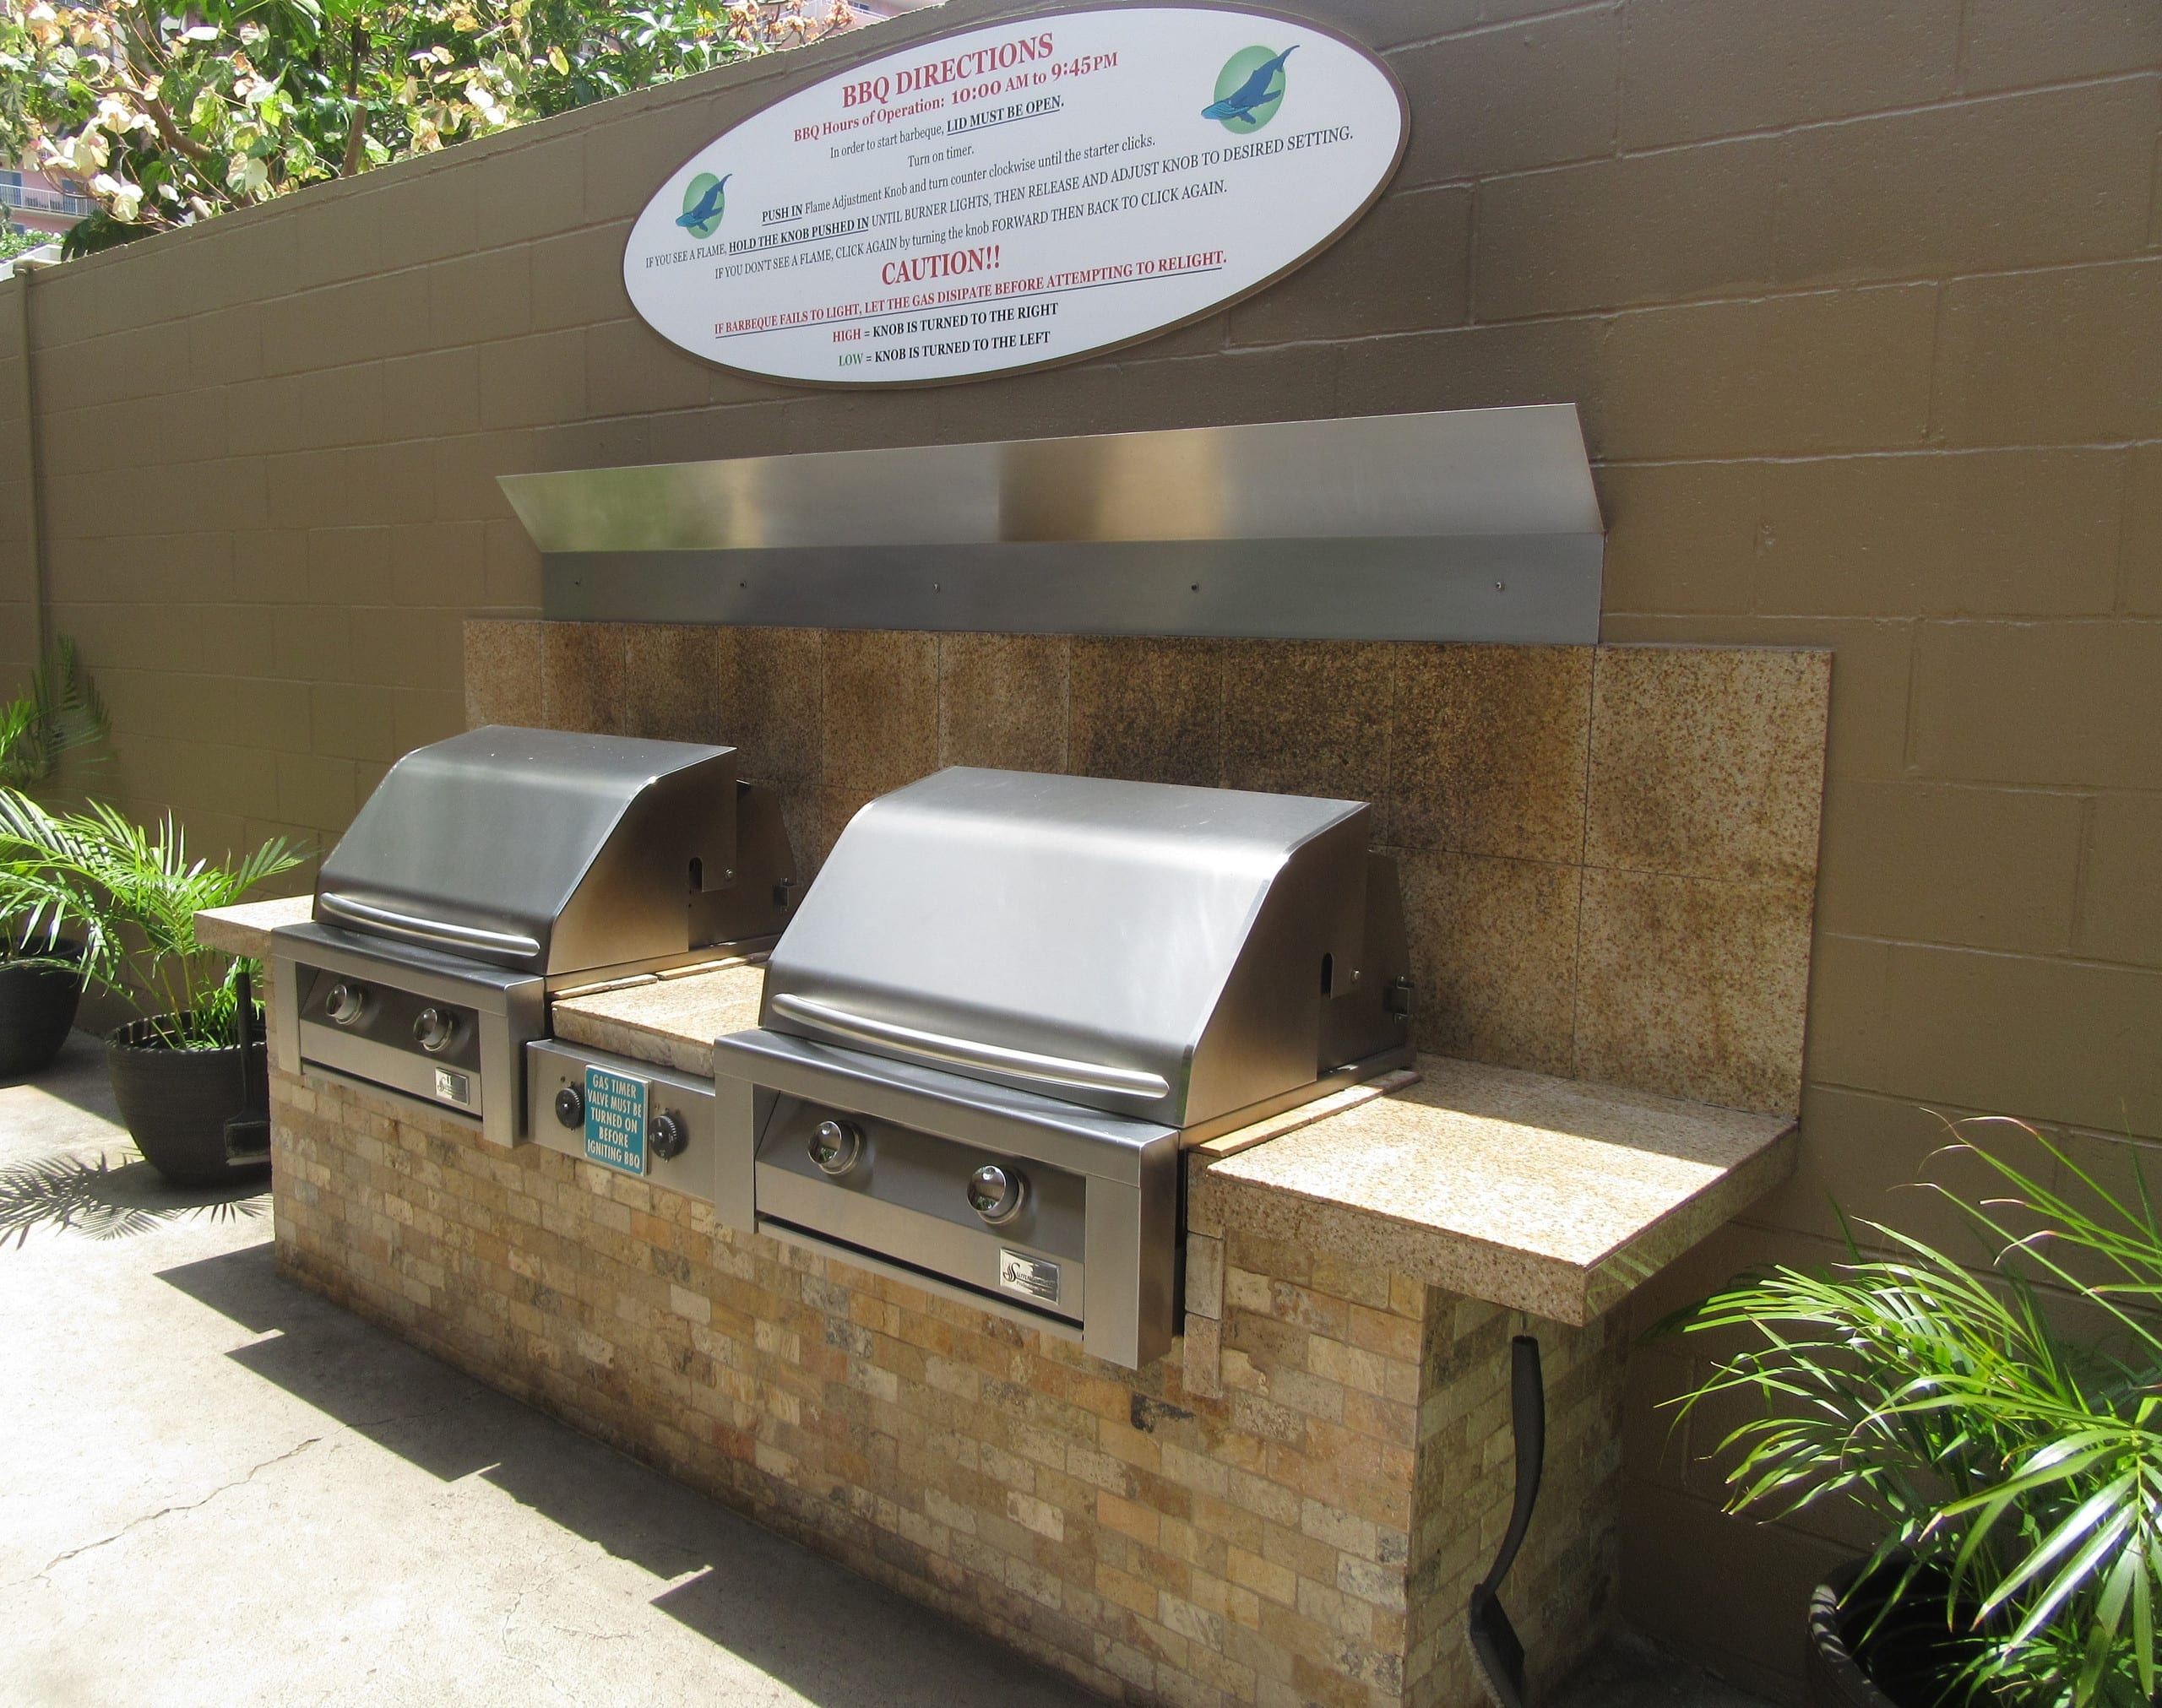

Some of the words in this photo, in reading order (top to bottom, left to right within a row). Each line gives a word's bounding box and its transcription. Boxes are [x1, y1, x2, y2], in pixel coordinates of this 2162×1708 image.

[843, 77, 889, 108] BBQ
[896, 33, 1052, 95] DIRECTIONS
[795, 125, 819, 142] BBQ
[823, 118, 859, 135] Hours
[862, 111, 875, 125] of
[877, 98, 943, 123] Operation:
[952, 81, 1001, 104] 10:00
[1006, 73, 1028, 92] AM
[1033, 73, 1046, 84] to
[831, 147, 839, 158] In
[842, 142, 865, 155] order
[867, 140, 875, 150] to
[877, 134, 897, 148] start
[900, 126, 943, 143] barbeque,
[948, 117, 967, 132] LID
[970, 108, 1004, 127] MUST
[1008, 104, 1023, 118] BE
[1026, 95, 1064, 114] OPEN.
[908, 155, 930, 167] Turn
[932, 152, 943, 162] on
[947, 146, 974, 160] timer.
[646, 257, 653, 268] IF
[655, 253, 671, 266] YOU
[673, 251, 687, 263] SEE
[689, 250, 695, 260] A
[698, 244, 726, 258] FLAME,
[730, 238, 756, 252] HOLD
[758, 234, 778, 247] THE
[781, 228, 809, 243] KNOB
[812, 220, 854, 237] PUSHED
[857, 216, 869, 230] IN
[872, 211, 902, 226] UNTIL
[905, 203, 947, 220] BURNER
[950, 194, 991, 212] LIGHTS,
[994, 187, 1024, 203] THEN
[1029, 176, 1079, 198] RELEASE
[1082, 171, 1108, 187] AND
[1111, 162, 1159, 182] ADJUST
[1163, 155, 1198, 173] KNOB
[1202, 151, 1220, 165] TO
[1224, 139, 1284, 162] DESIRED
[1288, 126, 1353, 150] SETTING.
[763, 207, 789, 222] PUSH
[792, 204, 802, 216] IN
[806, 201, 830, 214] Flame
[832, 189, 882, 209] Adjustment
[884, 182, 907, 198] Knob
[910, 178, 926, 193] and
[929, 178, 948, 189] turn
[951, 170, 986, 185] counter
[989, 159, 1035, 177] clockwise
[1039, 151, 1062, 167] until
[1065, 149, 1081, 162] the
[1084, 144, 1119, 159] starter
[1122, 133, 1154, 151] clicks.
[715, 268, 724, 279] IF
[725, 264, 742, 277] YOU
[774, 257, 790, 269] SEE
[791, 255, 797, 266] A
[801, 249, 834, 264] FLAME,
[836, 243, 863, 258] CLICK
[866, 237, 897, 253] AGAIN
[899, 236, 910, 250] by
[913, 230, 946, 246] turning
[948, 226, 963, 239] the
[966, 220, 989, 236] knob
[992, 211, 1048, 231] FORWARD
[1051, 204, 1084, 221] THEN
[1088, 198, 1118, 215] BACK
[1122, 195, 1138, 209] TO
[1142, 187, 1179, 206] CLICK
[1181, 180, 1226, 199] AGAIN.
[883, 245, 999, 285] CAUTION!!
[715, 323, 724, 333] IF
[725, 316, 777, 334] BARBEQUE
[780, 312, 807, 324] FAILS
[810, 309, 823, 320] TO
[827, 304, 861, 318] LIGHT,
[866, 300, 885, 313] LET
[887, 296, 910, 310] THE
[913, 293, 934, 306] GAS
[938, 285, 991, 303] DISIPATE
[996, 277, 1044, 295] BEFORE
[1046, 264, 1133, 288] ATTEMPTING
[1136, 261, 1154, 274] TO
[1159, 251, 1226, 272] RELIGHT.
[834, 328, 861, 342] HIGH
[873, 323, 904, 337] KNOB
[907, 321, 917, 333] IS
[920, 315, 968, 331] TURNED
[971, 312, 986, 324] TO
[989, 308, 1014, 323] THE
[1018, 302, 1058, 319] RIGHT
[839, 353, 863, 366] LOW
[876, 349, 905, 362] KNOB
[910, 347, 919, 358] IS
[922, 341, 970, 356] TURNED
[973, 339, 988, 351] TO
[991, 335, 1017, 349] THE
[1020, 331, 1051, 345] LEFT
[588, 1091, 608, 1108] VALVE
[611, 1096, 630, 1114] MUST
[633, 1103, 642, 1118] BE
[593, 1075, 608, 1091] GAS
[611, 1080, 636, 1098] TIMER
[591, 1107, 622, 1130] TURNED
[625, 1119, 637, 1134] ON
[599, 1126, 628, 1147] BEFORE
[588, 1139, 622, 1163] IGNITING
[624, 1152, 639, 1168] BBQ
